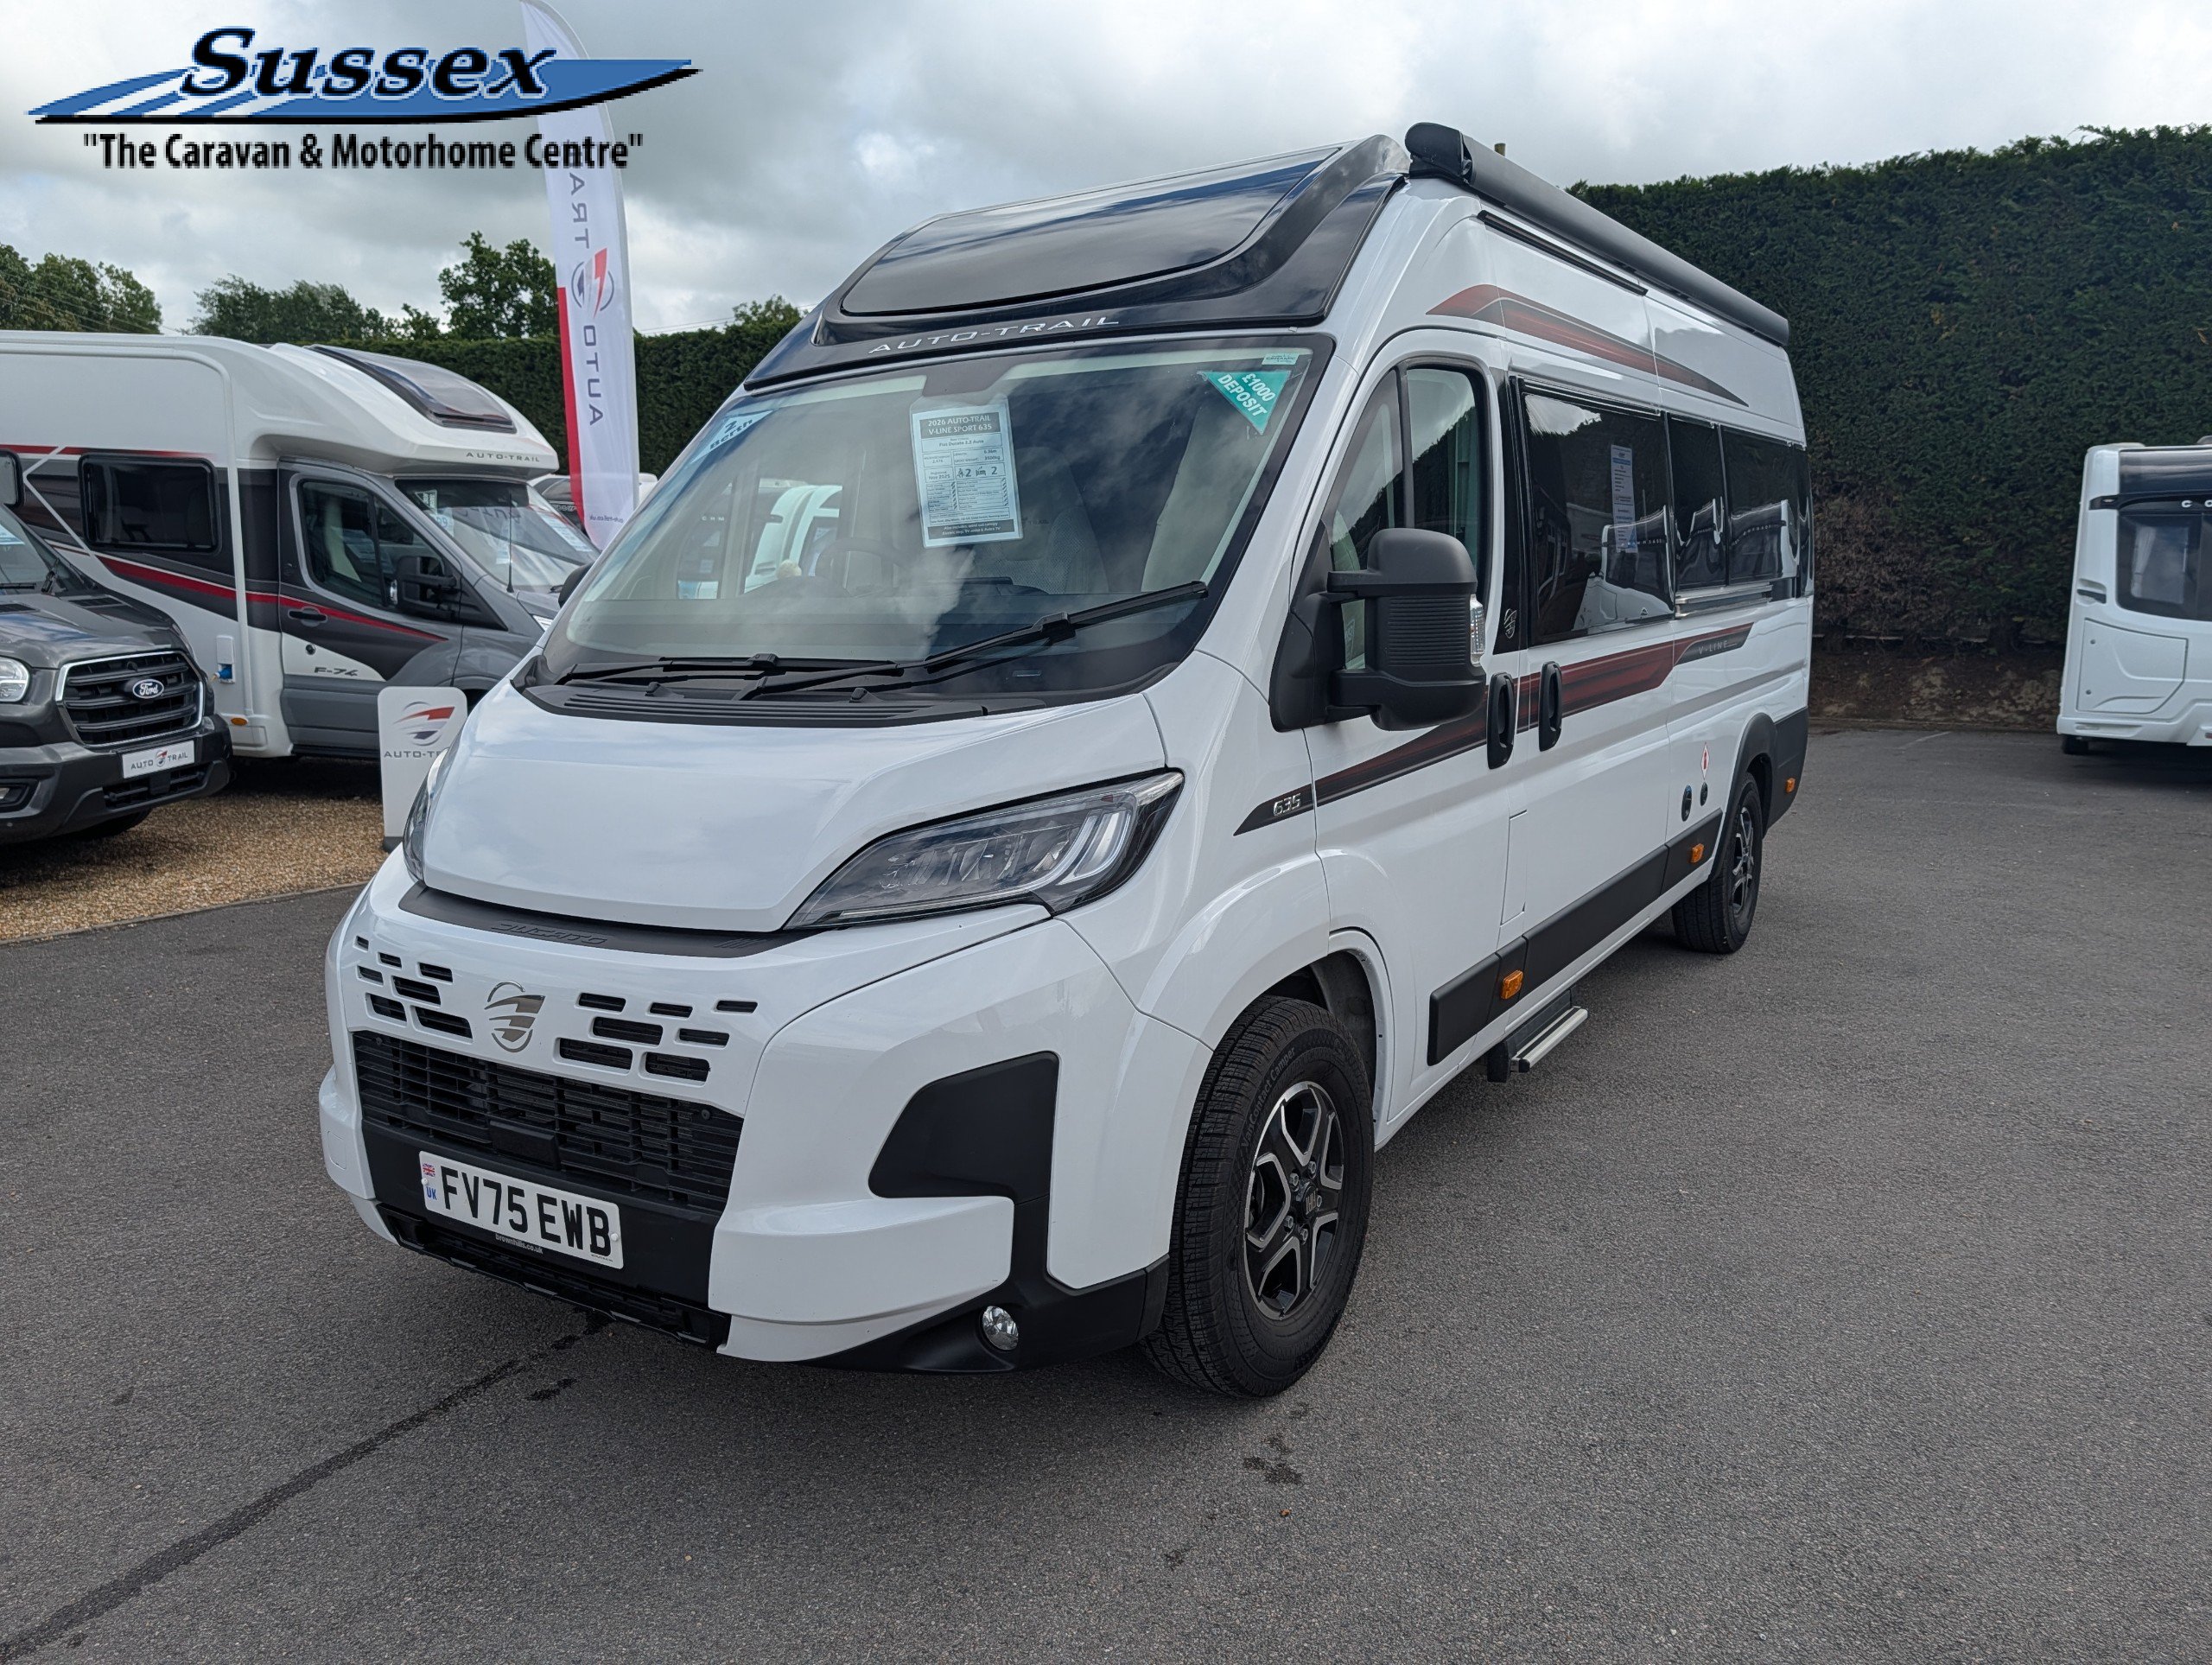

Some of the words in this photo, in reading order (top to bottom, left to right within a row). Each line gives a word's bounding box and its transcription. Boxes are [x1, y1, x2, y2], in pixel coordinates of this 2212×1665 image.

[868, 316, 1119, 354] AUTO-TRAIL
[1217, 374, 1268, 416] DEPOSIT
[1242, 373, 1276, 402] £1000
[724, 420, 737, 434] 2
[928, 417, 946, 427] 2026
[947, 415, 991, 424] AUTO-TRAIL
[710, 419, 753, 449] Berth
[929, 426, 952, 435] V-LINE
[954, 424, 976, 433] SPORT
[466, 452, 540, 462] AUTO-TRAIL
[965, 468, 972, 477] 2
[991, 467, 997, 475] 2
[1699, 640, 1728, 655] V-LINE
[139, 683, 159, 696] Ford
[130, 759, 154, 770] AUTO
[168, 752, 188, 762] TRAIL
[1273, 792, 1301, 817] 635
[1270, 1047, 1295, 1082] Camper
[425, 1186, 437, 1200] UK
[441, 1166, 529, 1234] FV75
[536, 1193, 612, 1257] EWB
[495, 1233, 543, 1255] brownhills.co.uk
